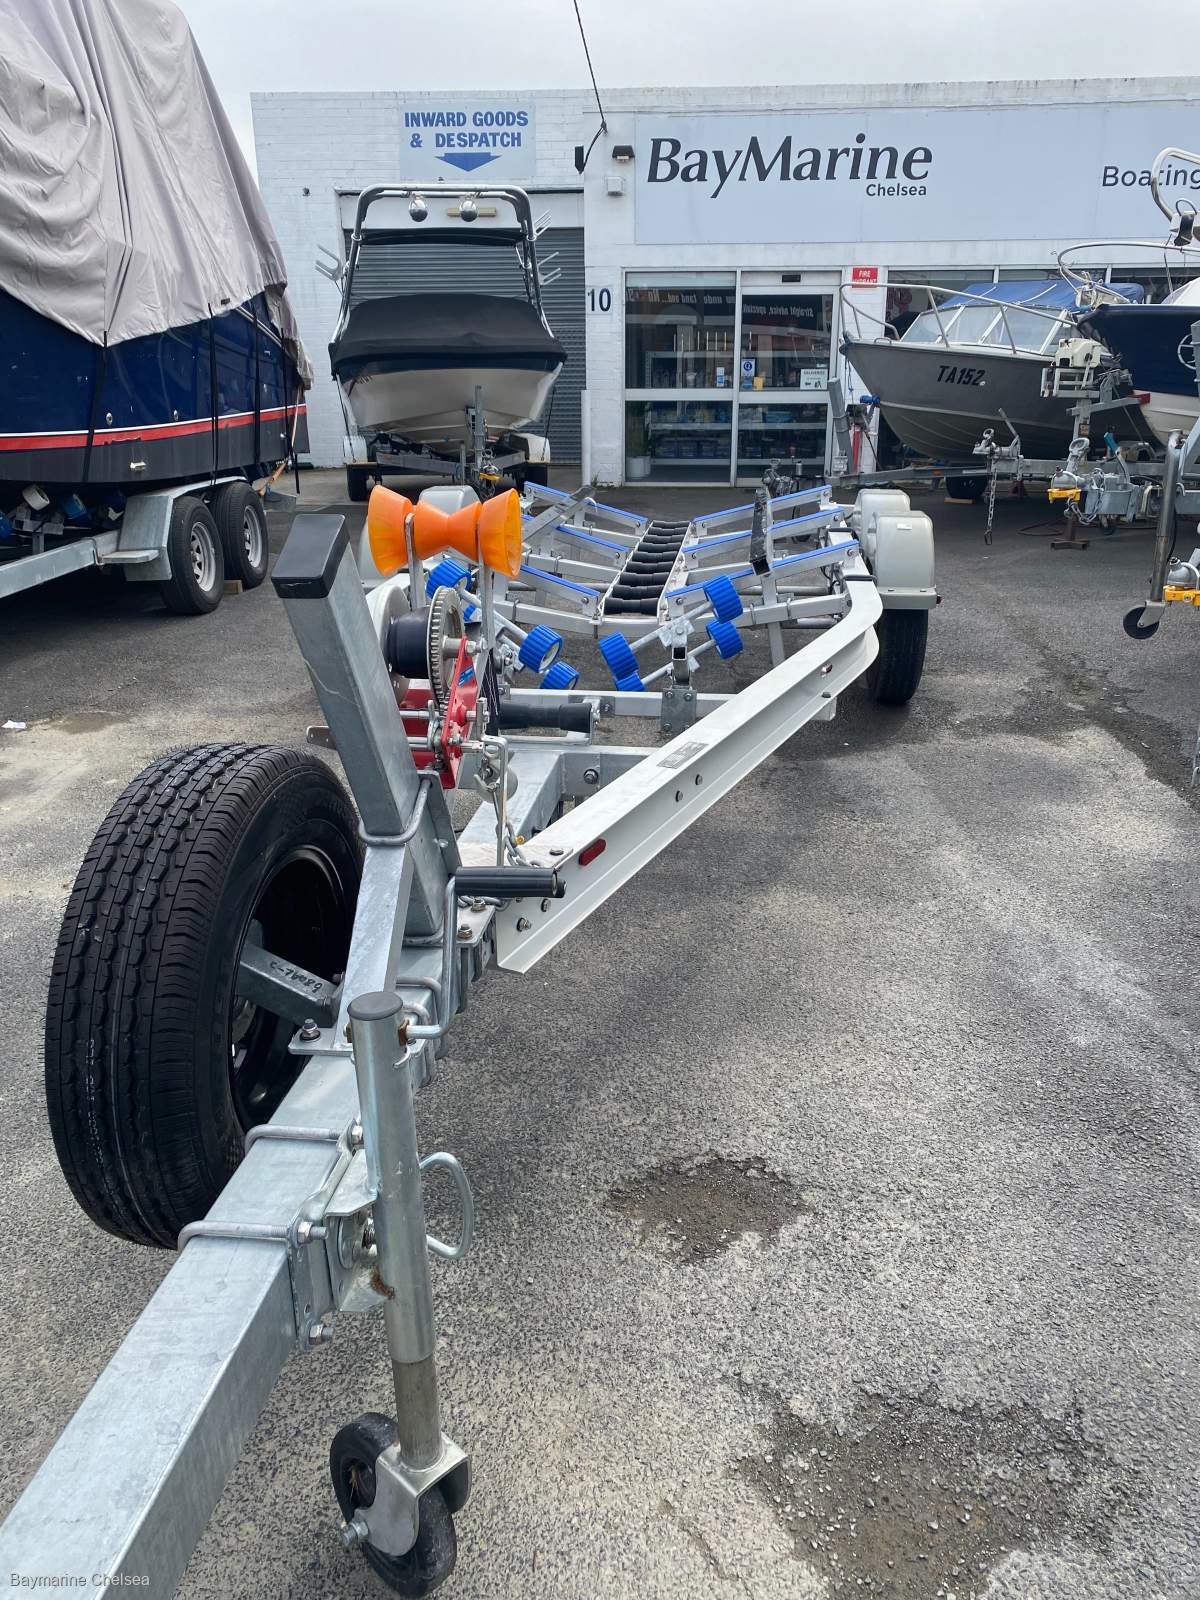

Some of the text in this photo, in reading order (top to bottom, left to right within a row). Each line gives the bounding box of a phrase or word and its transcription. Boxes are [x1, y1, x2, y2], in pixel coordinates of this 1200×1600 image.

[404, 110, 529, 128] INWARD GOODS
[410, 131, 522, 148] & DESPATCH
[647, 132, 933, 199] BayMarine
[1102, 164, 1200, 190] Boaing
[865, 183, 927, 197] Chelsea
[858, 270, 871, 278] FIRE
[587, 287, 612, 312] 10
[937, 365, 986, 386] TA152
